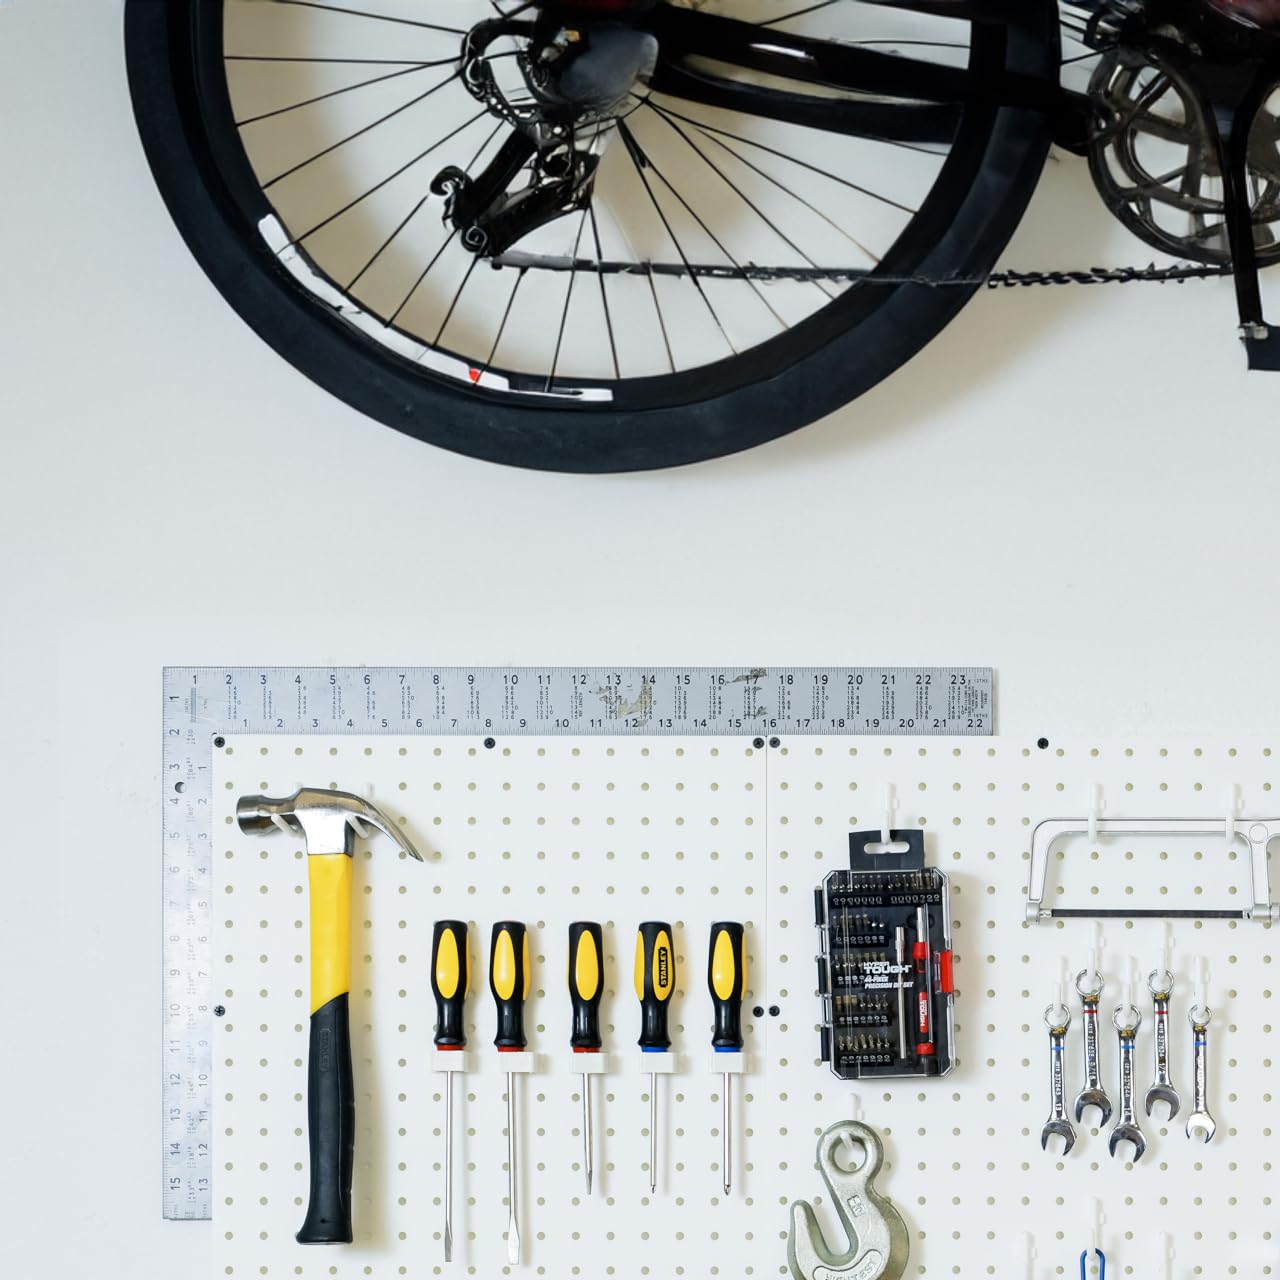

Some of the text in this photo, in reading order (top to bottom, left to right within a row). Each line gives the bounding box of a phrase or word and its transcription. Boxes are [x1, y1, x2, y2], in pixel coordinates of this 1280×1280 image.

[504, 674, 518, 685] 10
[538, 674, 550, 685] 11
[572, 674, 586, 685] 12
[676, 674, 690, 685] 15
[711, 674, 725, 685] 16
[780, 674, 794, 685] 18
[814, 674, 828, 685] 19
[848, 674, 863, 685] 20
[882, 674, 895, 685] 21
[916, 674, 931, 685] 22
[951, 674, 966, 685] 23
[556, 718, 569, 728] 10
[590, 718, 602, 728] 11
[625, 718, 639, 728] 12
[659, 718, 672, 728] 13
[694, 718, 707, 728] 14
[728, 718, 741, 728] 15
[763, 718, 777, 728] 16
[797, 718, 810, 728] 17
[831, 718, 845, 728] 18
[865, 718, 879, 728] 19
[899, 718, 914, 728] 20
[933, 718, 946, 728] 21
[968, 718, 983, 728] 22
[659, 949, 667, 986] STANLEY
[864, 965, 909, 974] TOUGH
